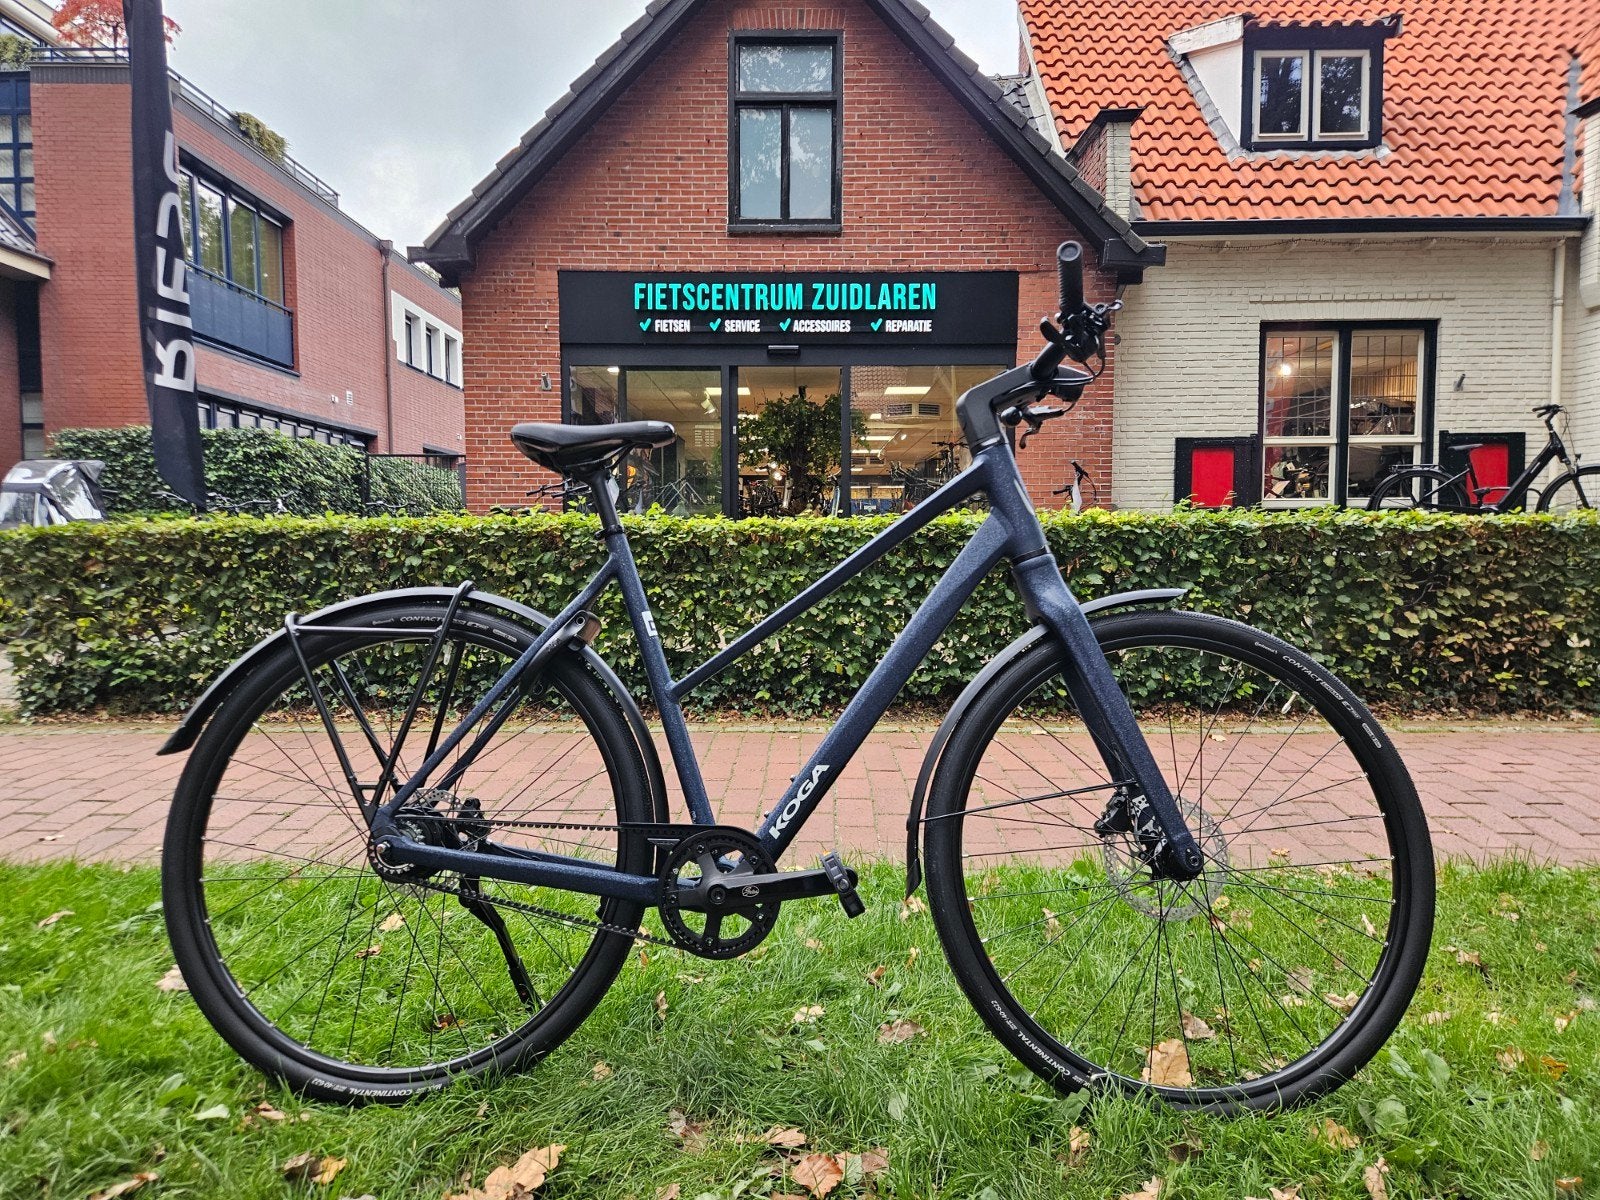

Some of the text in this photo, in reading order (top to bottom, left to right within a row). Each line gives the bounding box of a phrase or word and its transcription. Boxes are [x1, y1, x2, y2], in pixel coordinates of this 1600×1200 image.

[634, 282, 936, 311] FIETSCENTRUM ZUIDLAREN
[654, 319, 691, 333] FIETSEN
[724, 319, 761, 333] SERVICE
[792, 319, 851, 333] ACCESSOIRES
[885, 319, 933, 333] REPARATIE
[1282, 655, 1322, 683] CONTACT
[768, 764, 830, 839] KOGA
[1018, 1031, 1071, 1076] CONTINENTAL
[349, 1087, 412, 1097] CONTINENTAL
